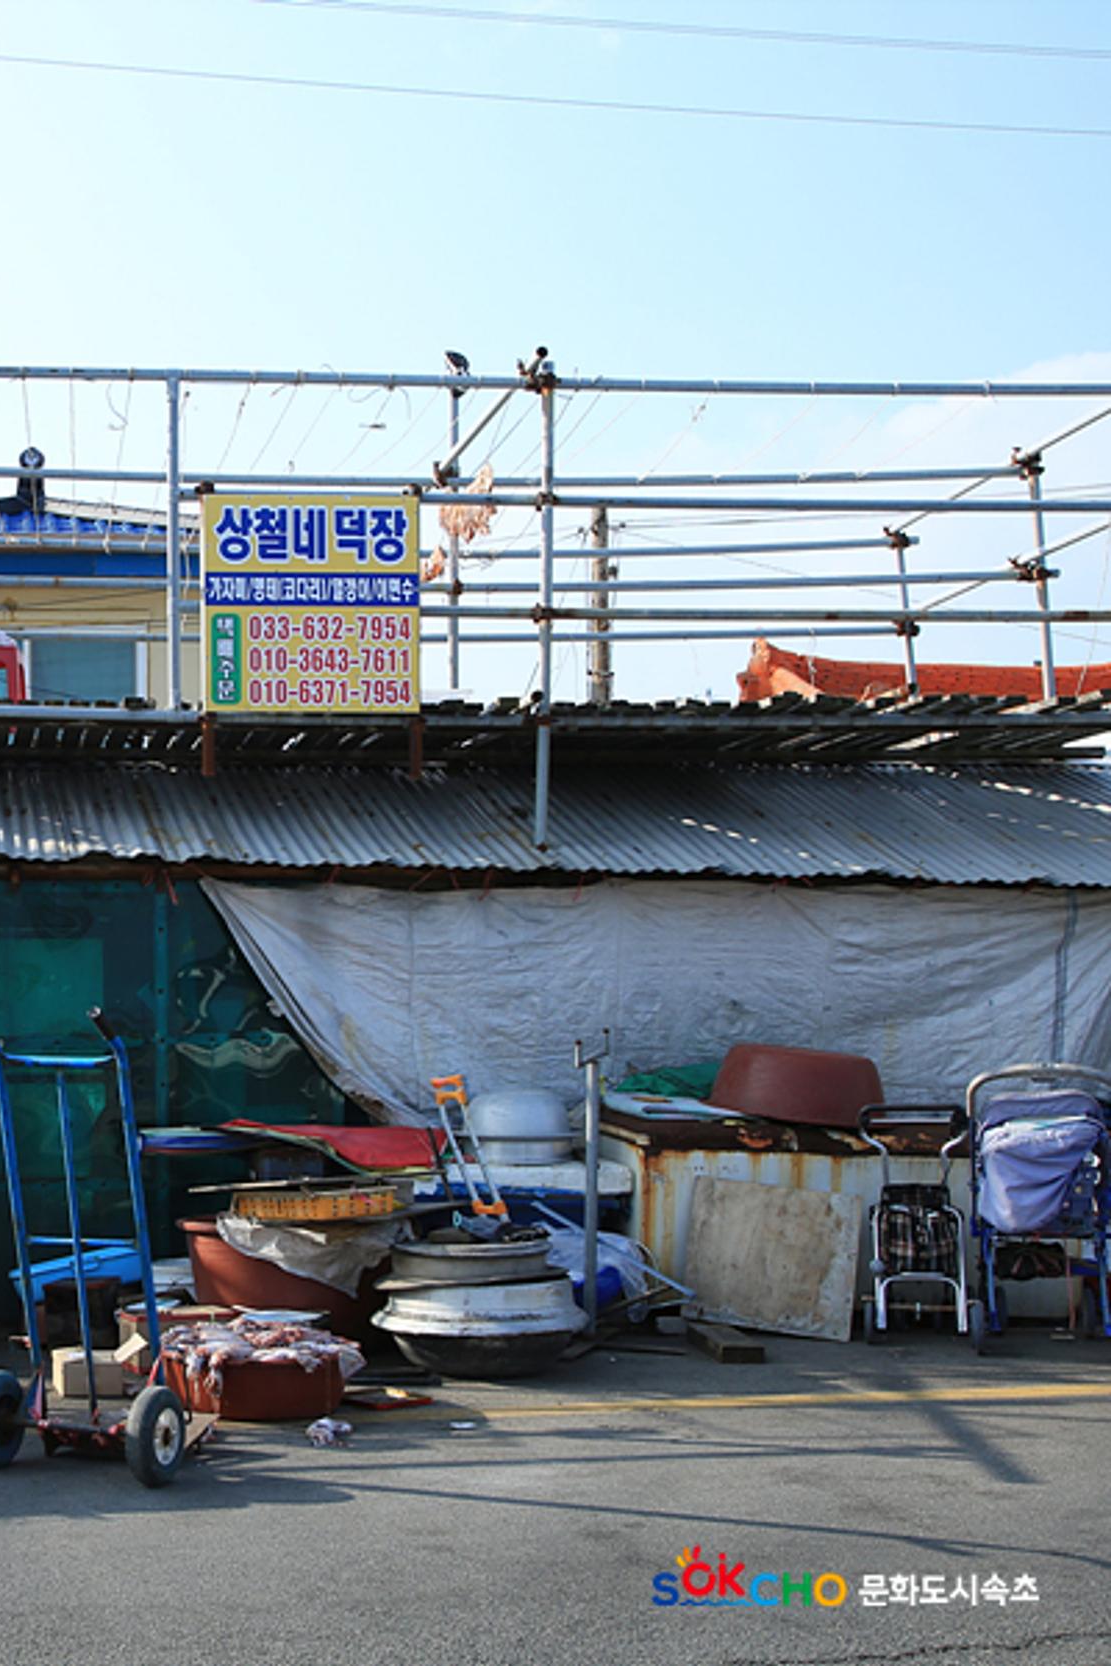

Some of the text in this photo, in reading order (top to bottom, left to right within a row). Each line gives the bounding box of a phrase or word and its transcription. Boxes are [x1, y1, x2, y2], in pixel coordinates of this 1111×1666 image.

[215, 506, 408, 563] 상철네 덕장
[248, 615, 411, 641] 033-632-7954
[248, 647, 410, 673] 010-3643-7611
[248, 679, 411, 705] 010-6371-7954
